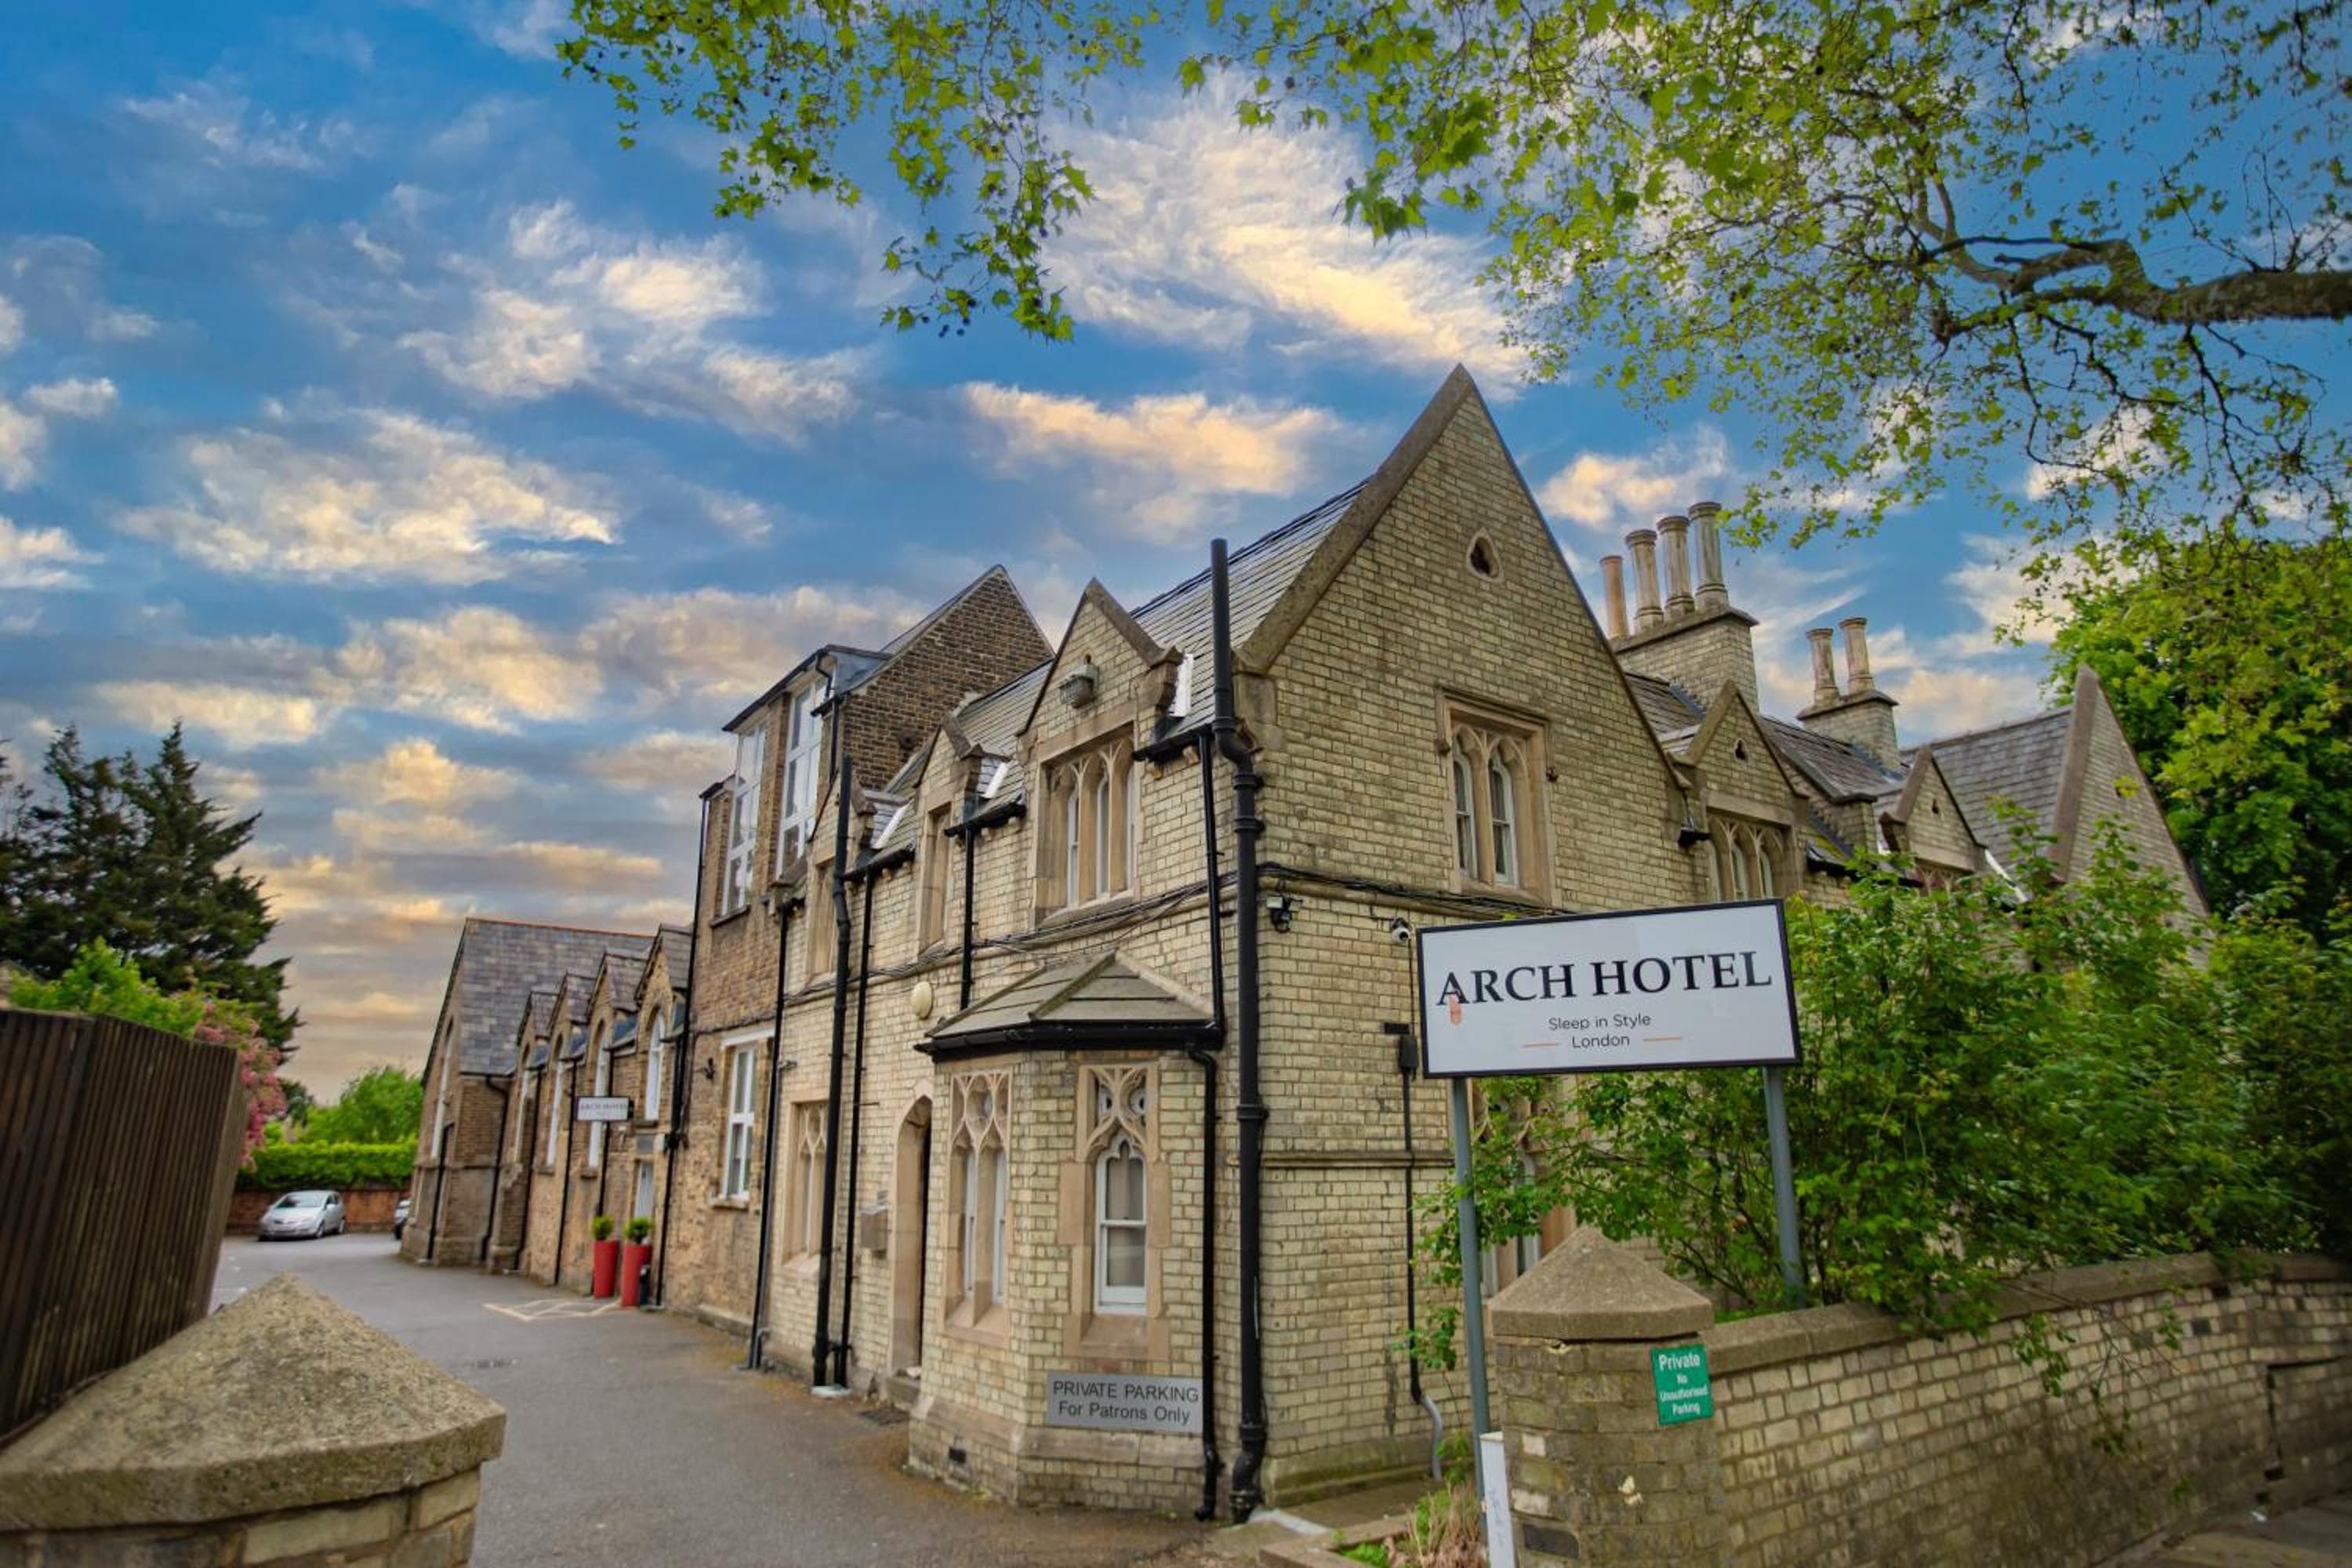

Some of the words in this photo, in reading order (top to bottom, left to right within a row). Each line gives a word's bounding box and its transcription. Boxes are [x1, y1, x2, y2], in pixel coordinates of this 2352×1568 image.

[1436, 964, 1577, 1005] ARCH
[1590, 951, 1772, 997] HOTEL
[1548, 1016, 1590, 1031] Sleep
[1595, 1015, 1608, 1028] in
[1613, 1013, 1651, 1029] Style
[1572, 1033, 1630, 1049] London
[1658, 1352, 1700, 1371] Private
[1053, 1380, 1117, 1398] PRIVATE
[1124, 1384, 1199, 1403] PARKING
[1059, 1401, 1083, 1416] For
[1089, 1402, 1147, 1420] Patrons
[1155, 1406, 1190, 1426] Only
[1672, 1403, 1700, 1415] Parking
